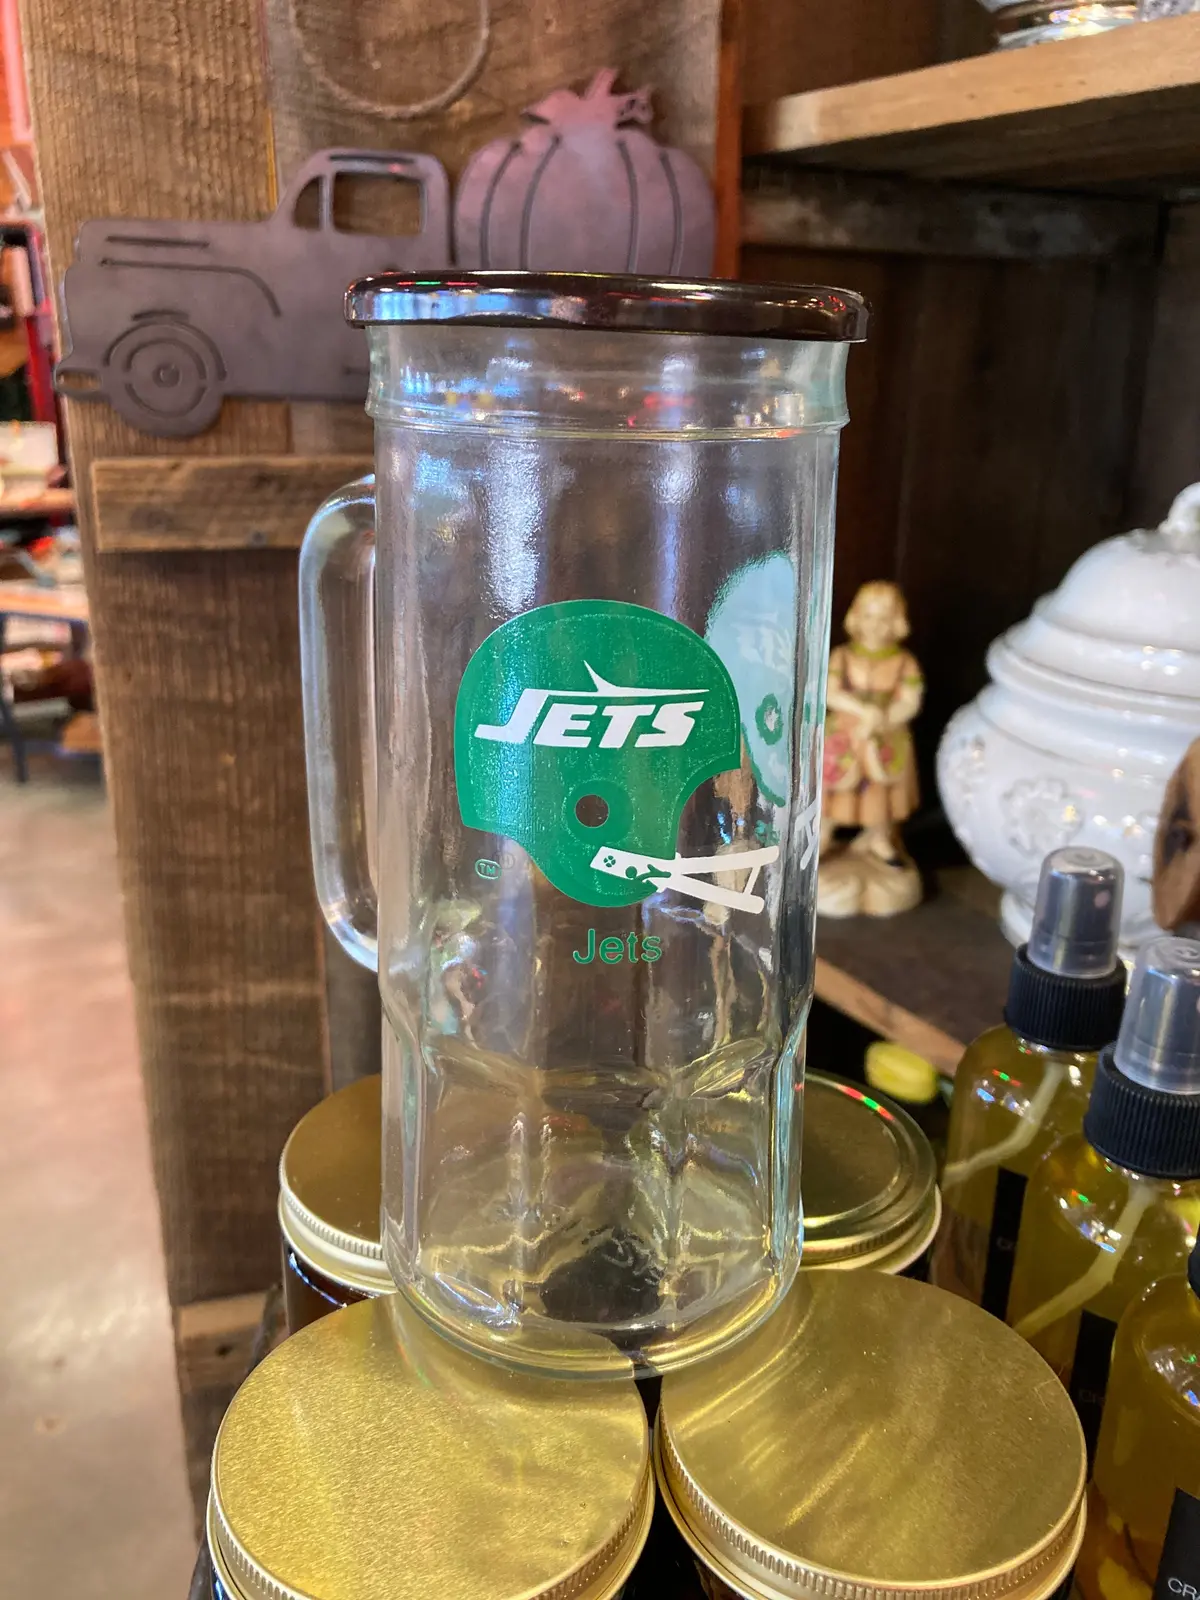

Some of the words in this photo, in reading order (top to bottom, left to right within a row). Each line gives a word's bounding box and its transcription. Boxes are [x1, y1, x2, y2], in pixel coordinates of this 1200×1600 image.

[474, 688, 709, 749] JETS
[572, 928, 662, 965] Jets
[1167, 1577, 1200, 1600] CR
